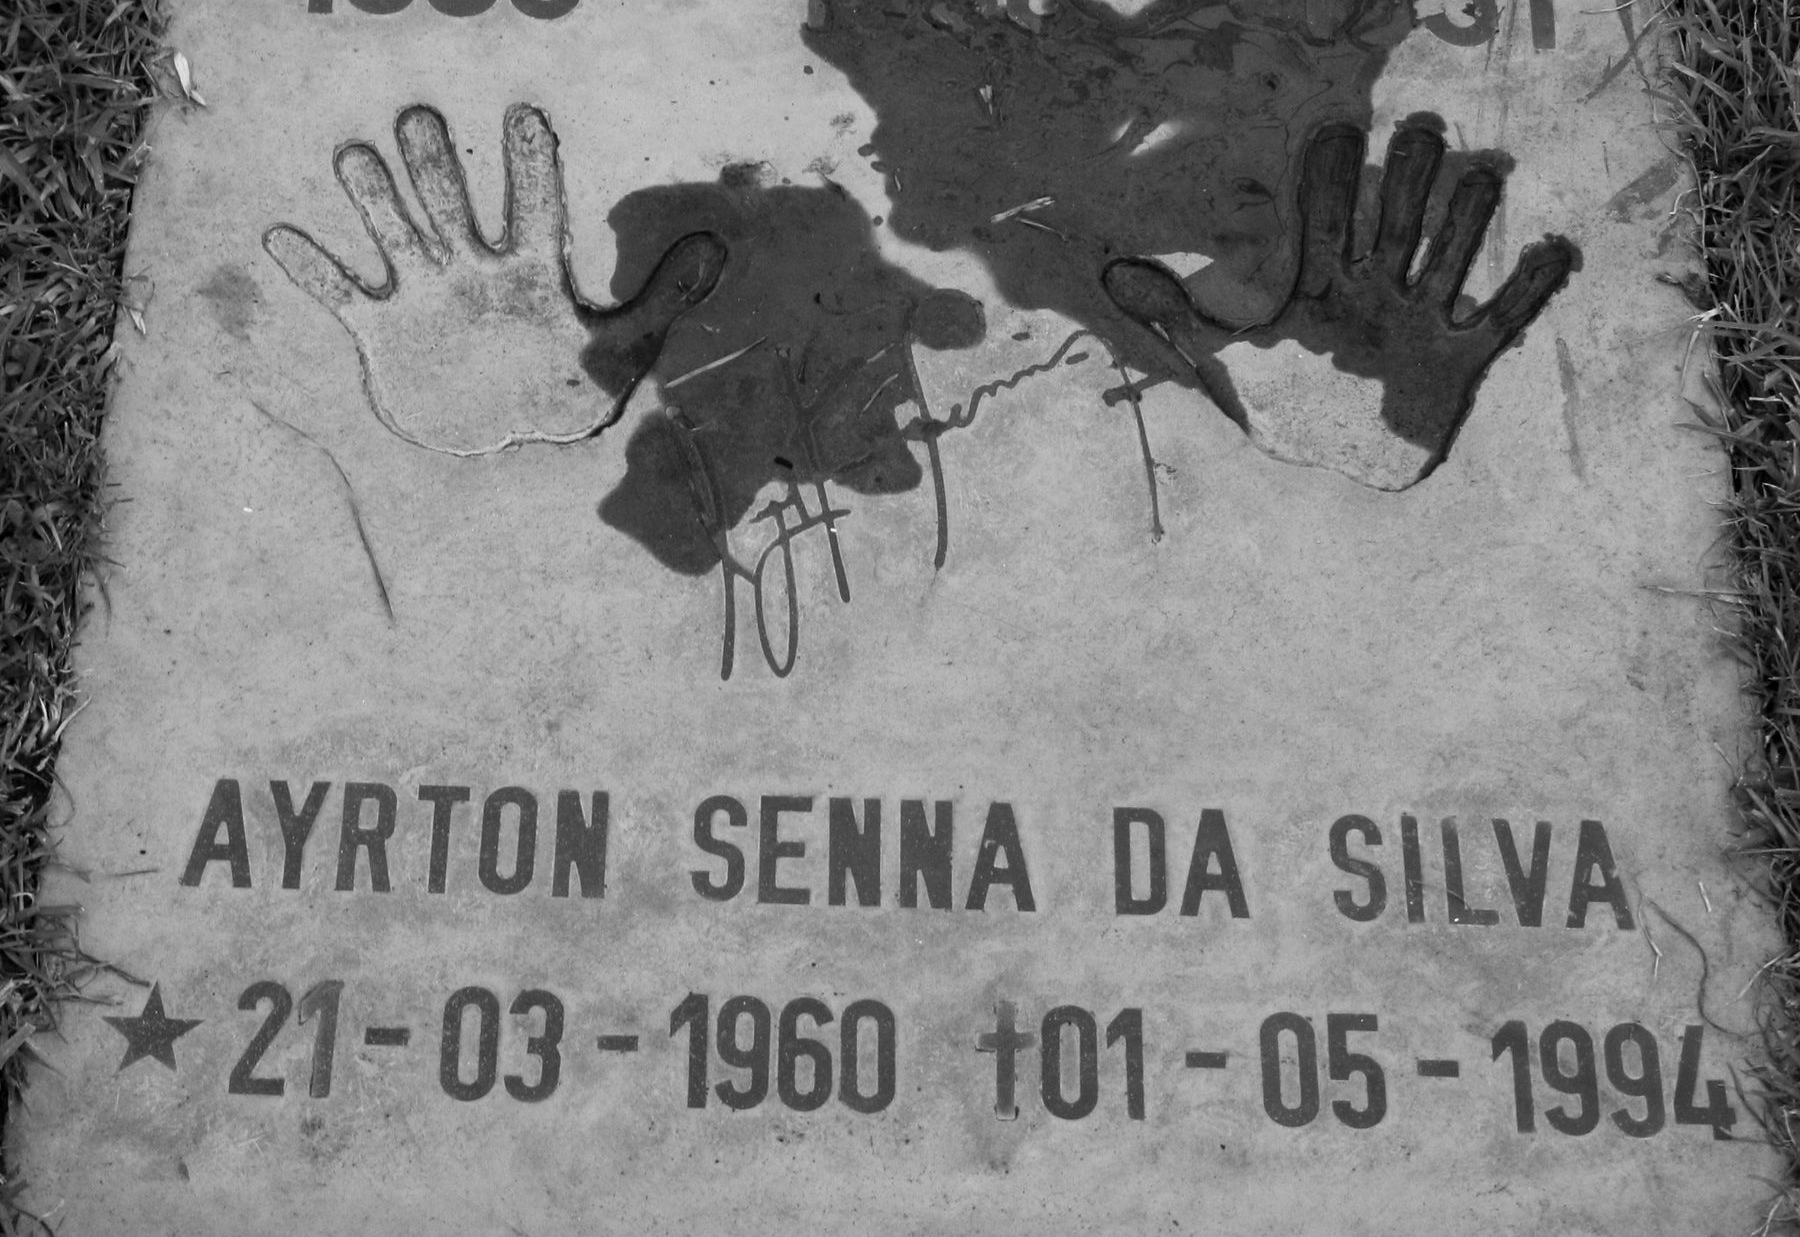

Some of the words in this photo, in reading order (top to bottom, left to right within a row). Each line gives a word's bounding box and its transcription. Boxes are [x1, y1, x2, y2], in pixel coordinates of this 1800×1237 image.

[179, 778, 610, 899] AYRTON
[690, 793, 1037, 913] SENNA
[1112, 806, 1251, 920] DA
[1327, 813, 1637, 931] SILVA
